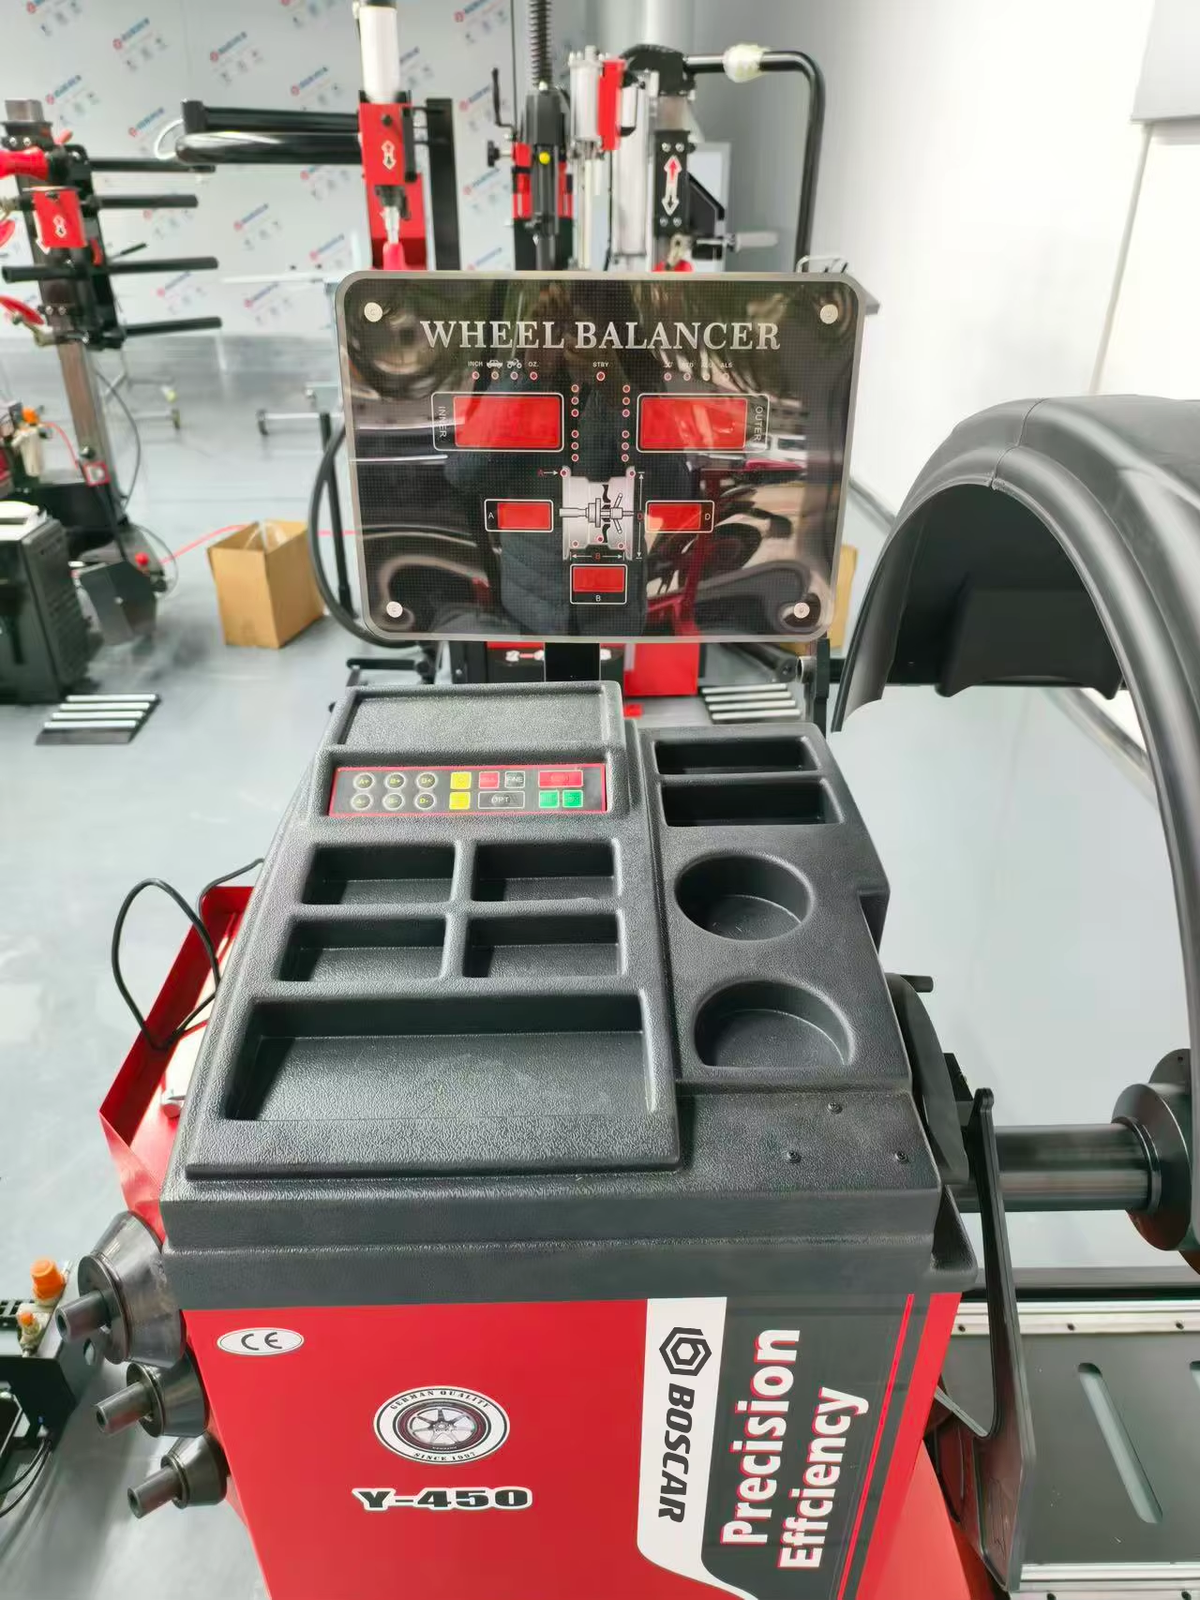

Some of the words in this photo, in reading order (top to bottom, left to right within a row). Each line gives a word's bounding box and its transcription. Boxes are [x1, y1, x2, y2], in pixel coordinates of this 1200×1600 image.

[419, 320, 565, 349] WHEEL
[574, 321, 781, 350] BALANCER
[438, 406, 447, 438] INNER
[753, 406, 764, 441] OUTER
[704, 513, 711, 521] D
[595, 594, 602, 602] B
[241, 1332, 282, 1351] CE
[390, 1390, 435, 1410] GERMAN
[439, 1390, 492, 1409] QUALITY
[720, 1329, 801, 1545] Precision
[413, 1452, 447, 1461] SINCE
[658, 1382, 696, 1523] BOSCAR
[355, 1488, 530, 1509] Y-450
